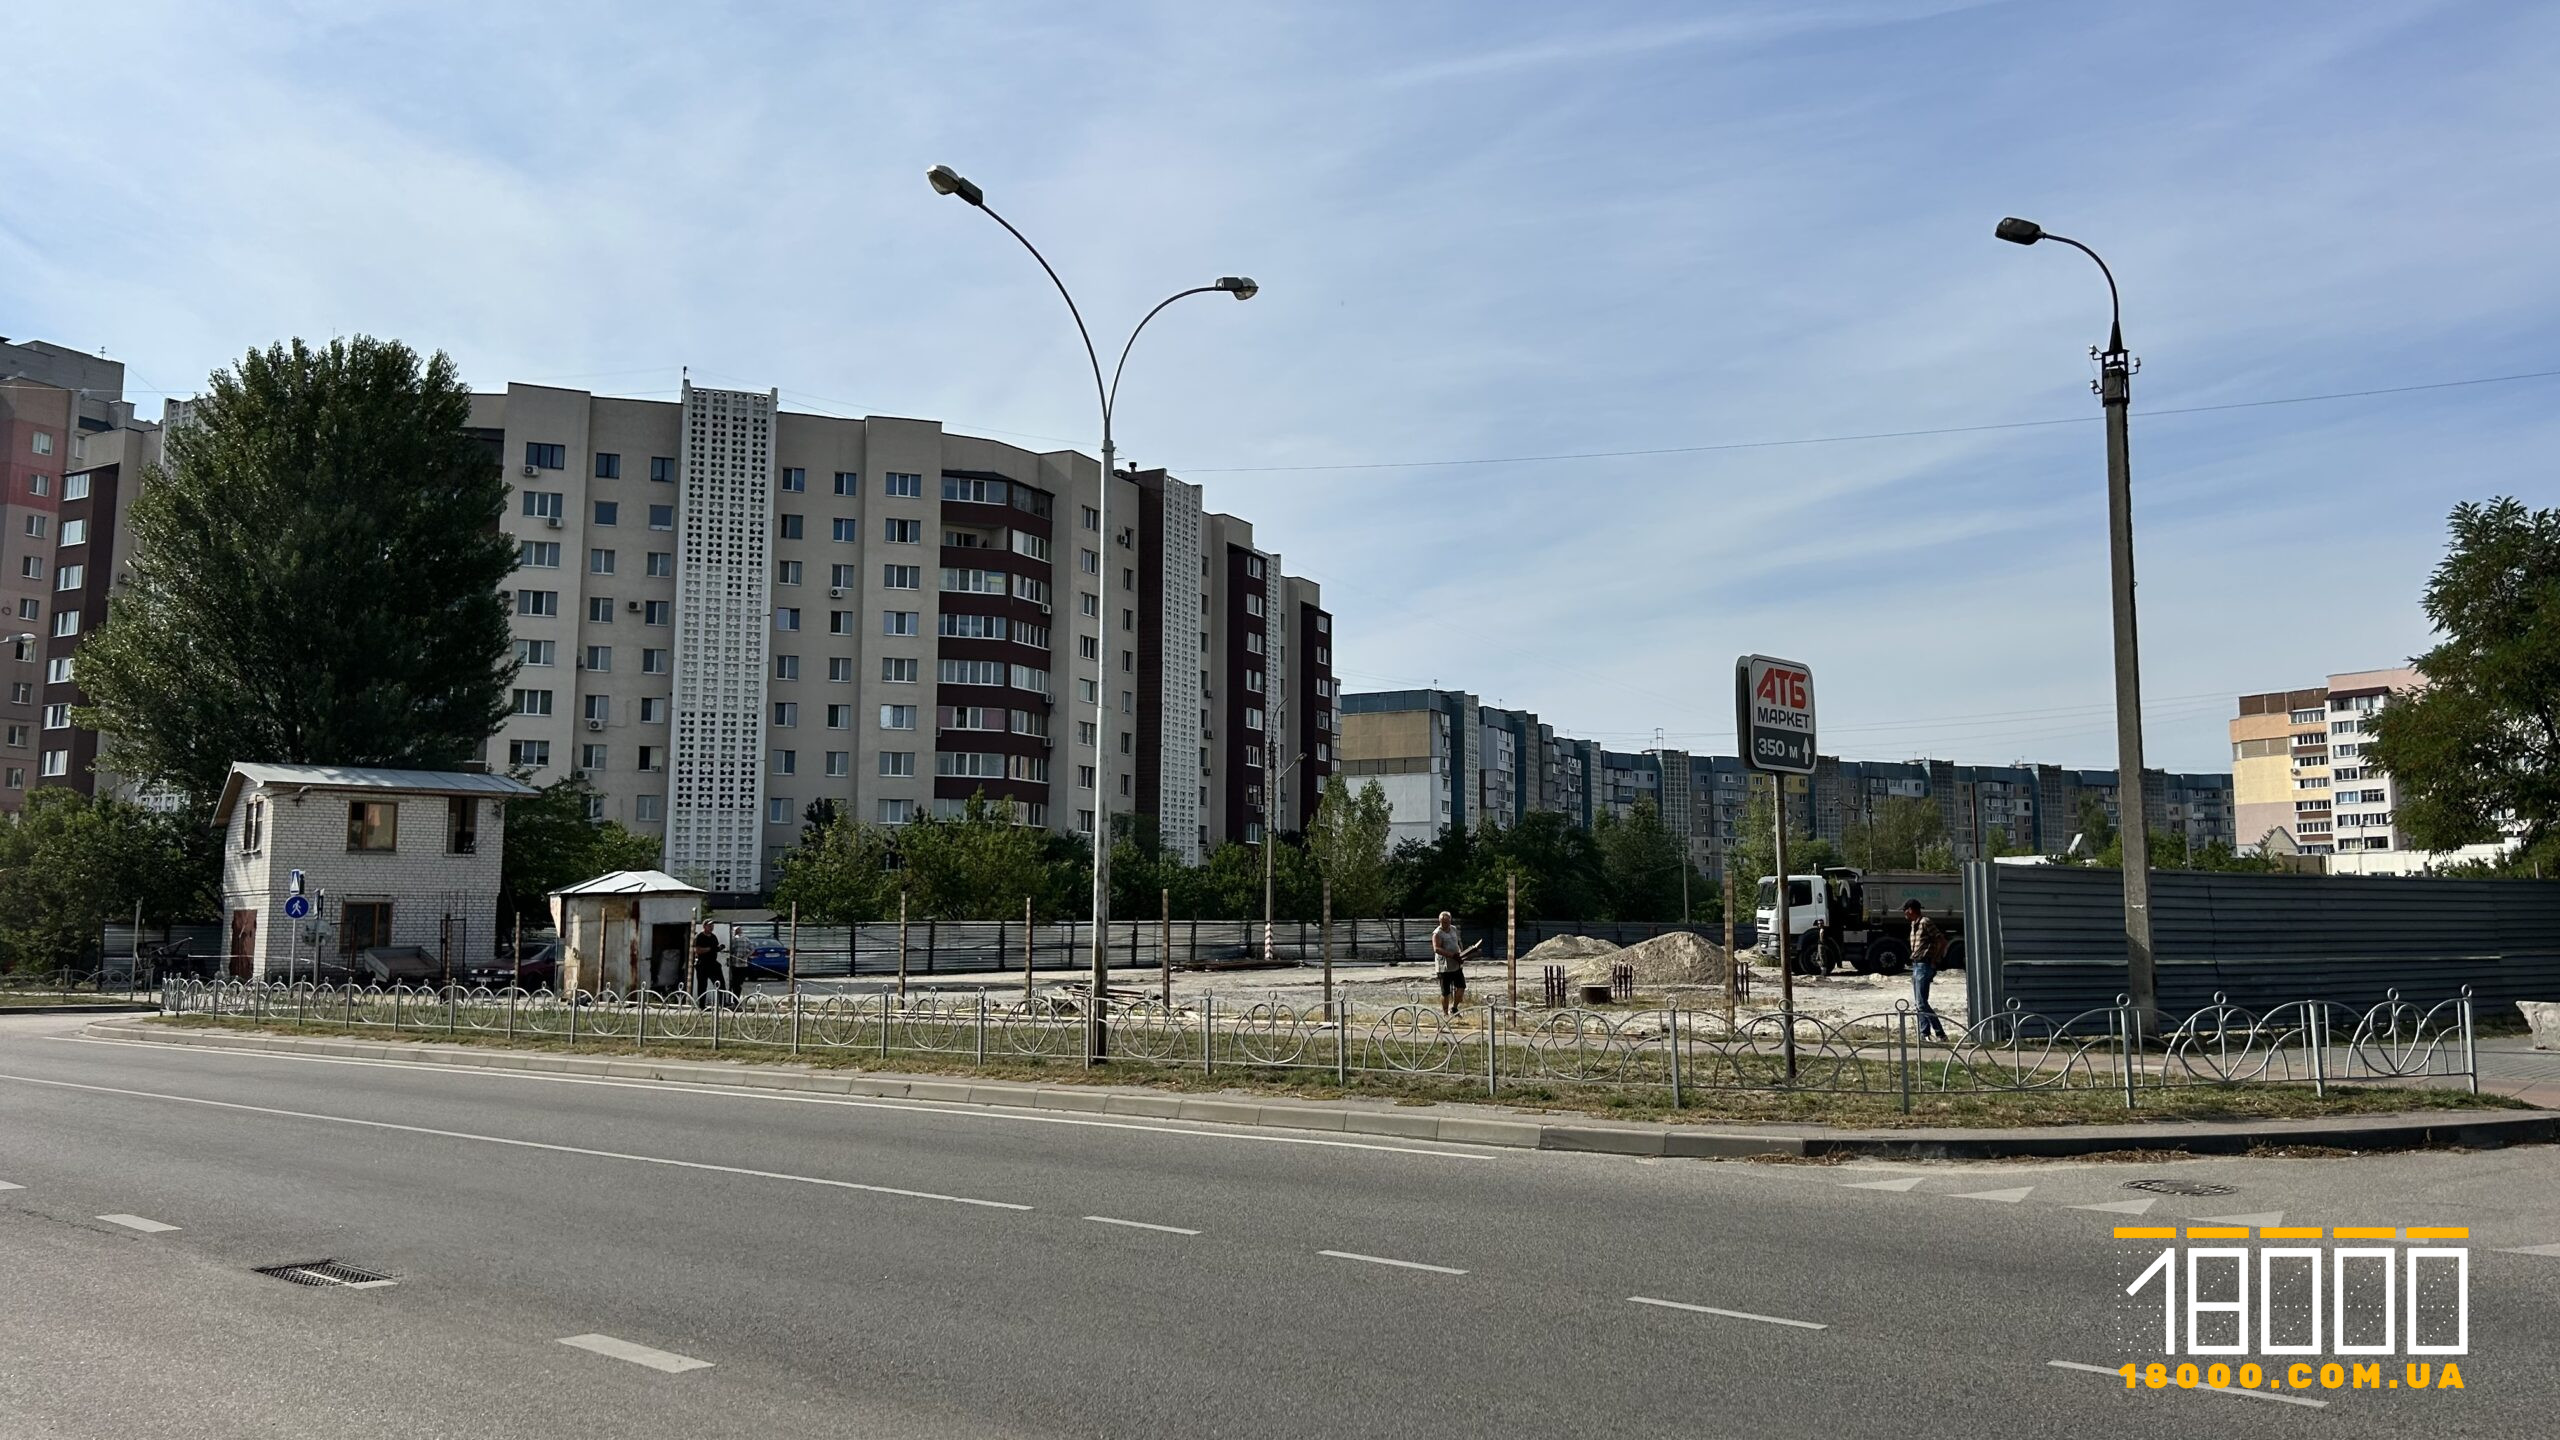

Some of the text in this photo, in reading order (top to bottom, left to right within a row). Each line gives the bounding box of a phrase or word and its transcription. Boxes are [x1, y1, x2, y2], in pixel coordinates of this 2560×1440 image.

[1757, 667, 1807, 709] АТБ
[1757, 706, 1810, 729] МАРКЕТ
[1758, 737, 1785, 757] 350
